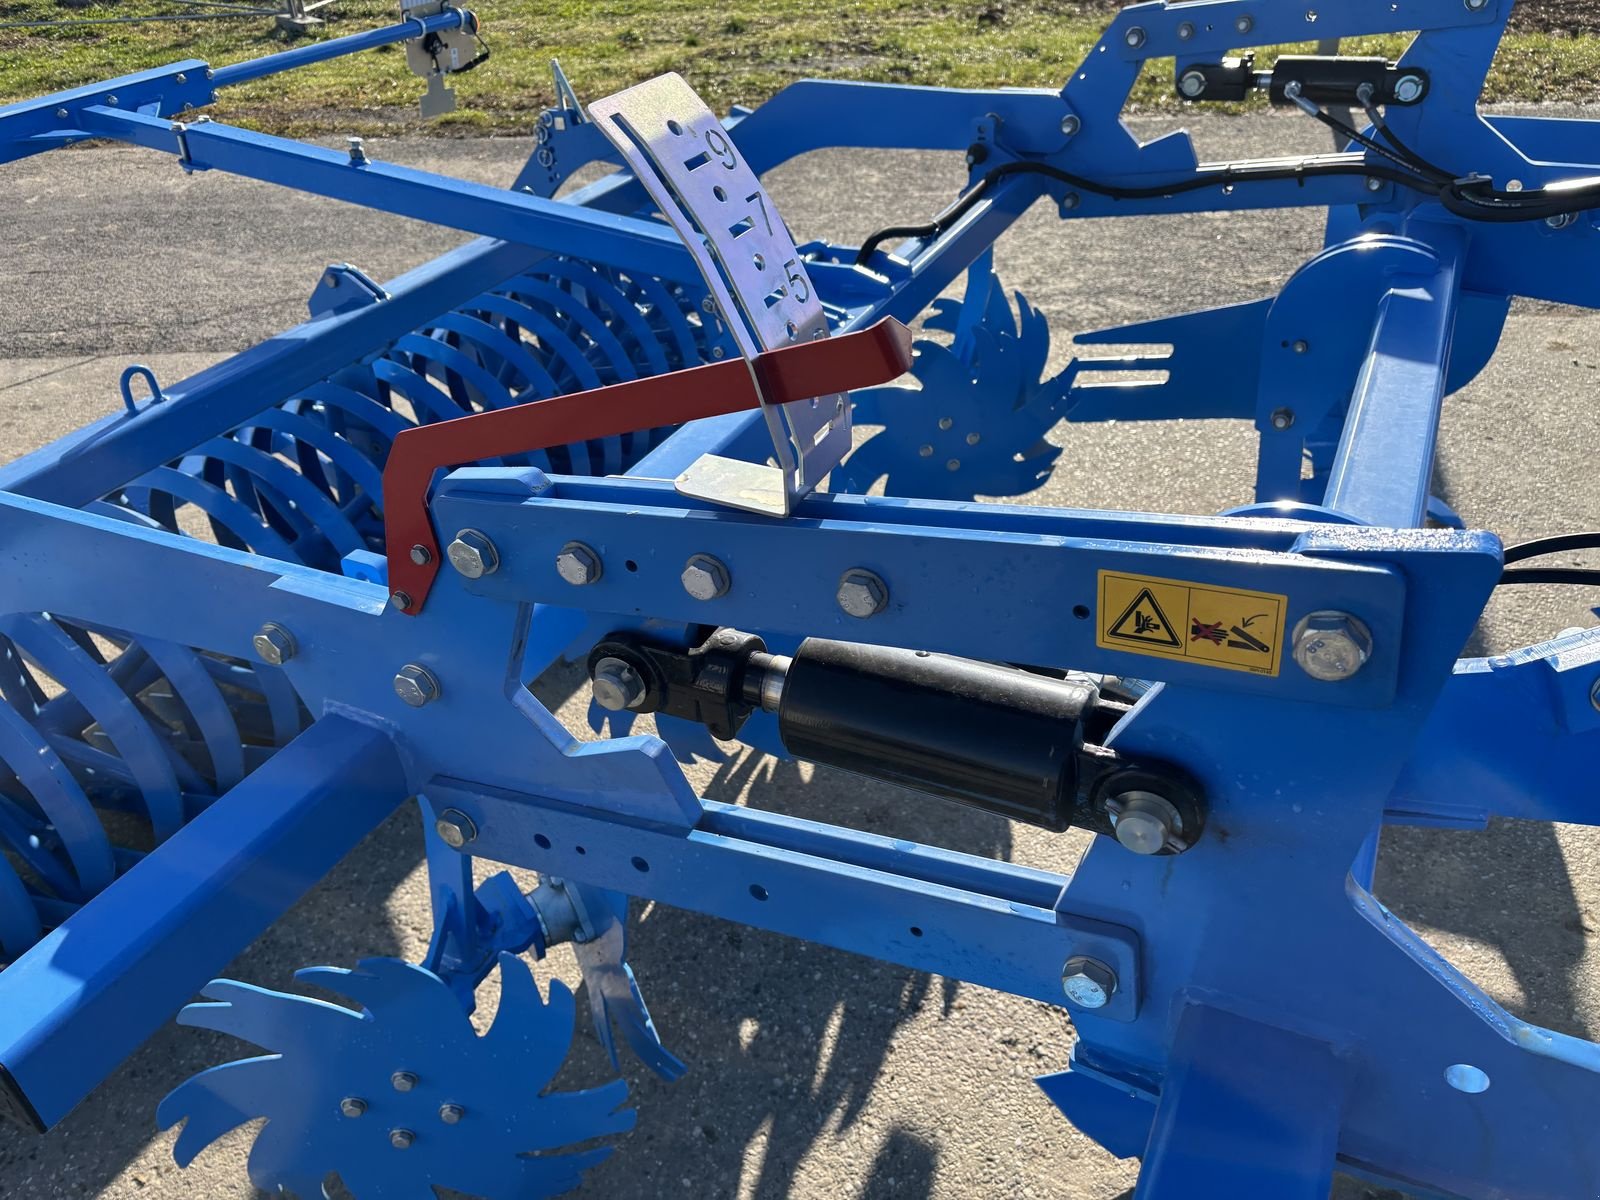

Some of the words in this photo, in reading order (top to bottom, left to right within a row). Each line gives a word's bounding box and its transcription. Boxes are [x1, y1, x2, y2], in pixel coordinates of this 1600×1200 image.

[705, 129, 737, 170] 9
[745, 191, 774, 237] 7
[784, 259, 810, 304] 5
